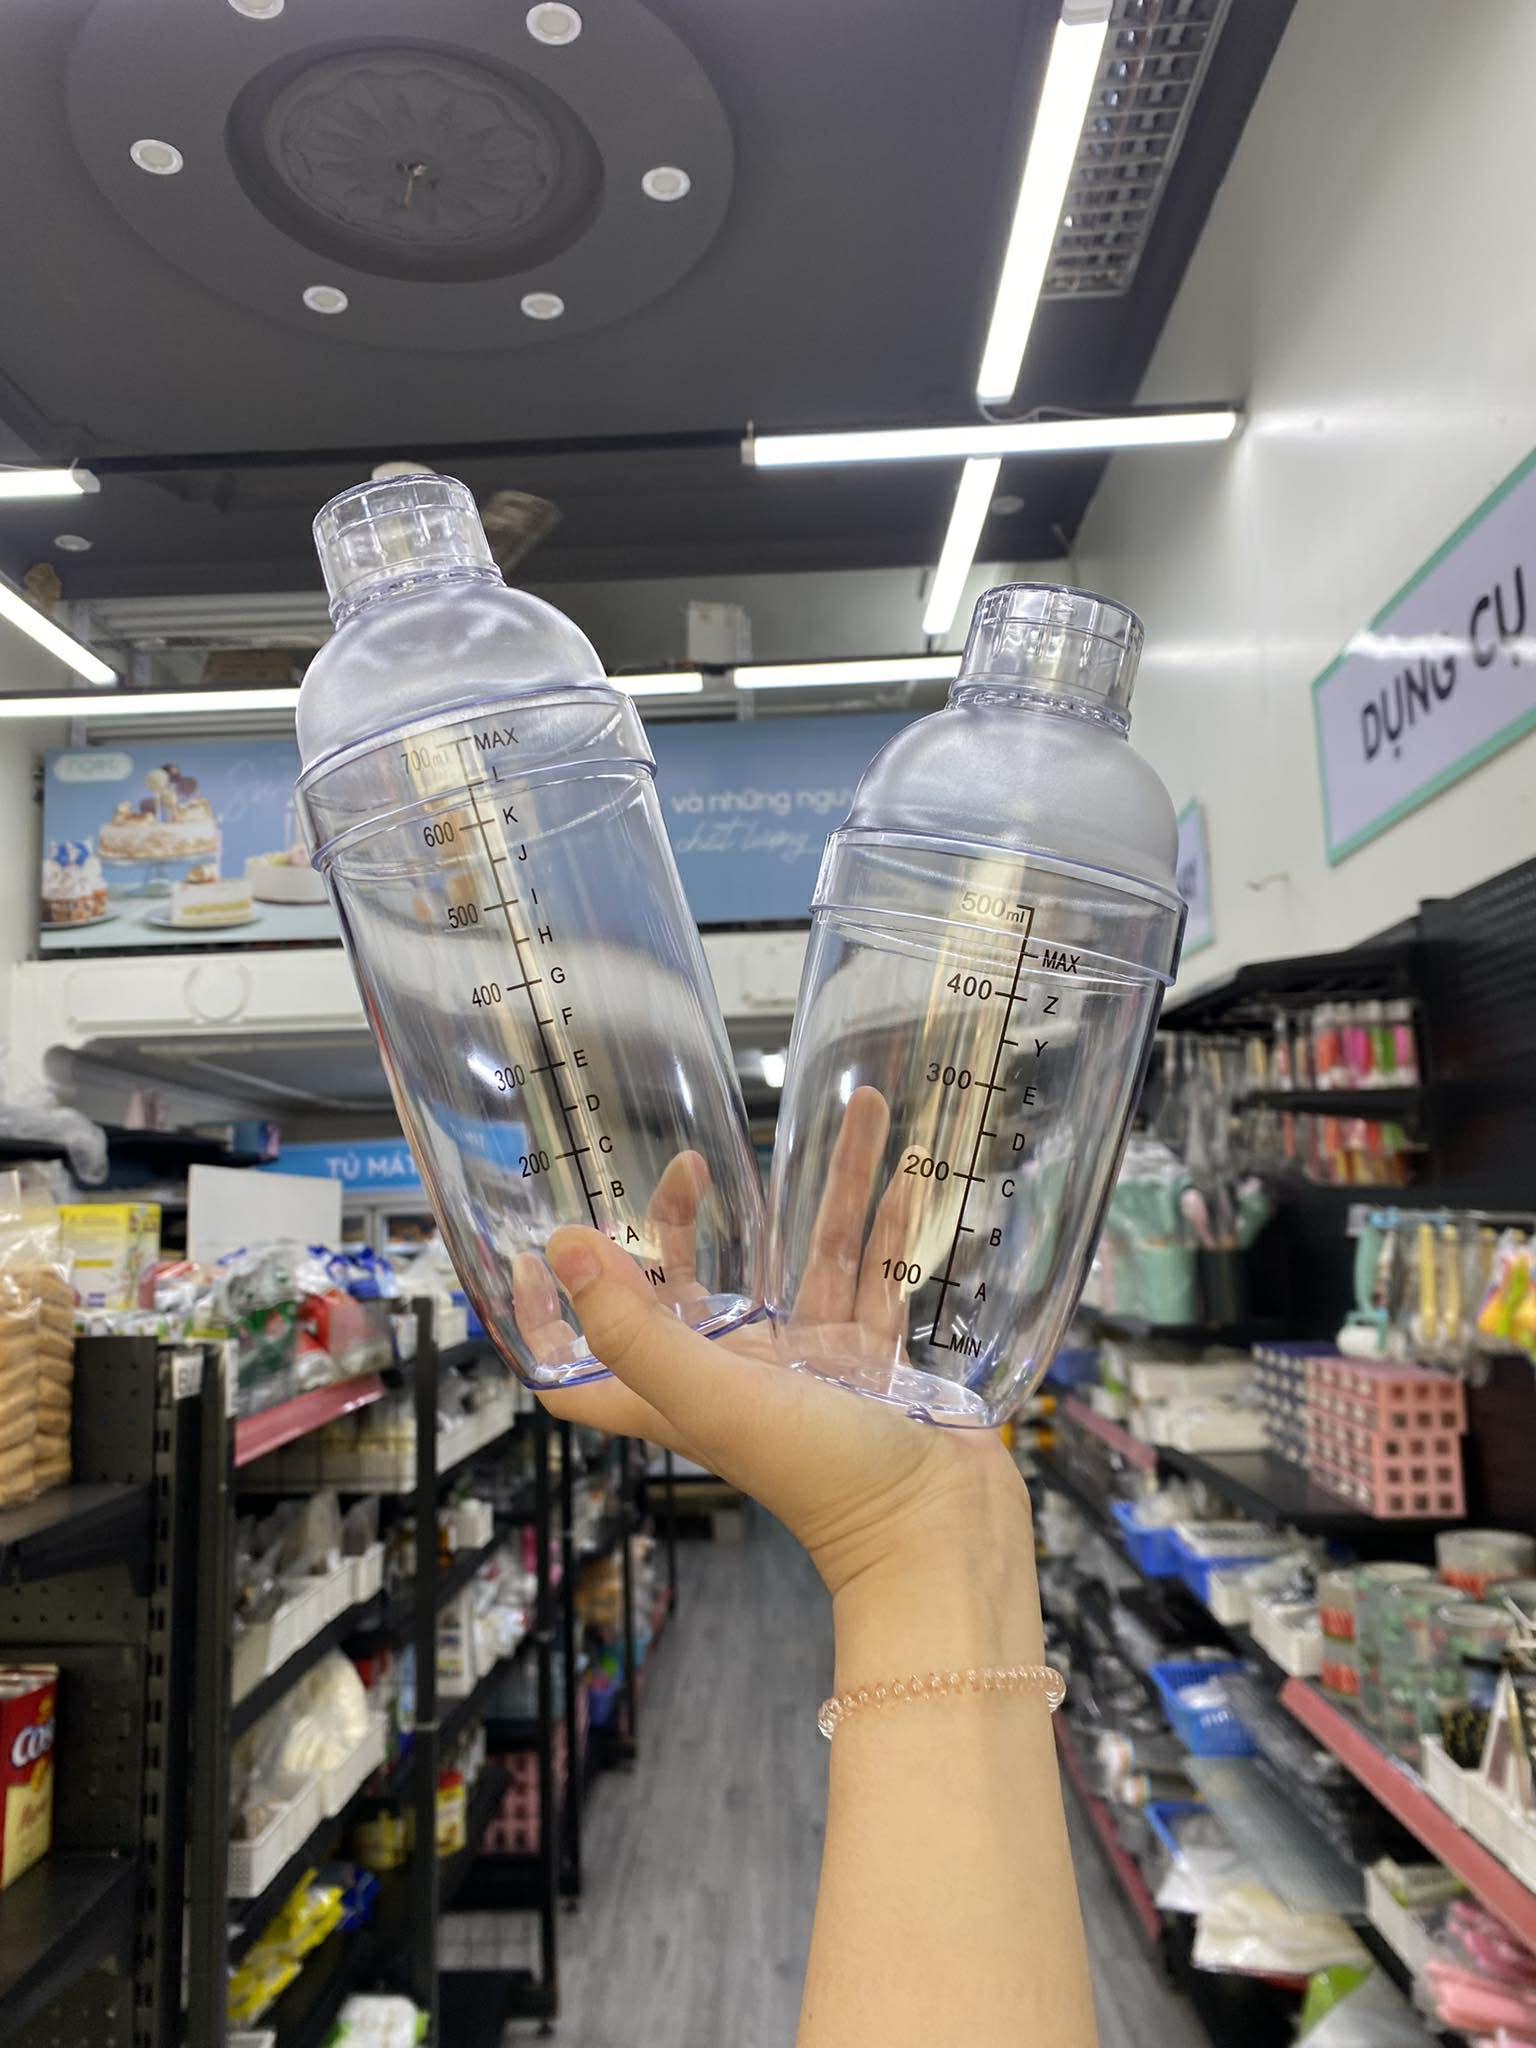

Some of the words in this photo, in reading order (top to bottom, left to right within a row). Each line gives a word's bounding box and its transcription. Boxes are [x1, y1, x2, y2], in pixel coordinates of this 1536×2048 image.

[1361, 640, 1458, 761] DỤNG
[1468, 565, 1527, 670] CỤ
[473, 728, 519, 752] MAX
[491, 766, 505, 783] L
[502, 806, 519, 825] K
[423, 821, 455, 848] 600
[517, 844, 529, 861] J
[447, 903, 479, 930] 500
[961, 891, 1025, 924] 500ml
[538, 926, 554, 944] H
[1042, 949, 1081, 974] MAX
[550, 967, 566, 985] G
[471, 982, 502, 1008] 400
[947, 973, 993, 1001] 400
[1043, 995, 1059, 1015] Z
[562, 1007, 574, 1026] F
[1033, 1039, 1048, 1058] Y
[574, 1049, 589, 1069] E
[494, 1064, 526, 1093] 300
[926, 1062, 972, 1090] 300
[586, 1094, 601, 1112] D
[1022, 1087, 1036, 1105] E
[599, 1136, 613, 1154] C
[1012, 1133, 1026, 1152] D
[518, 1150, 550, 1178] 200
[903, 1154, 950, 1182] 200
[611, 1180, 625, 1199] B
[1001, 1179, 1016, 1198] C
[625, 1226, 640, 1245] A
[988, 1228, 1002, 1247] B
[644, 1266, 666, 1286] IN
[881, 1257, 922, 1285] 100
[974, 1282, 988, 1302] A
[949, 1334, 983, 1359] MIN
